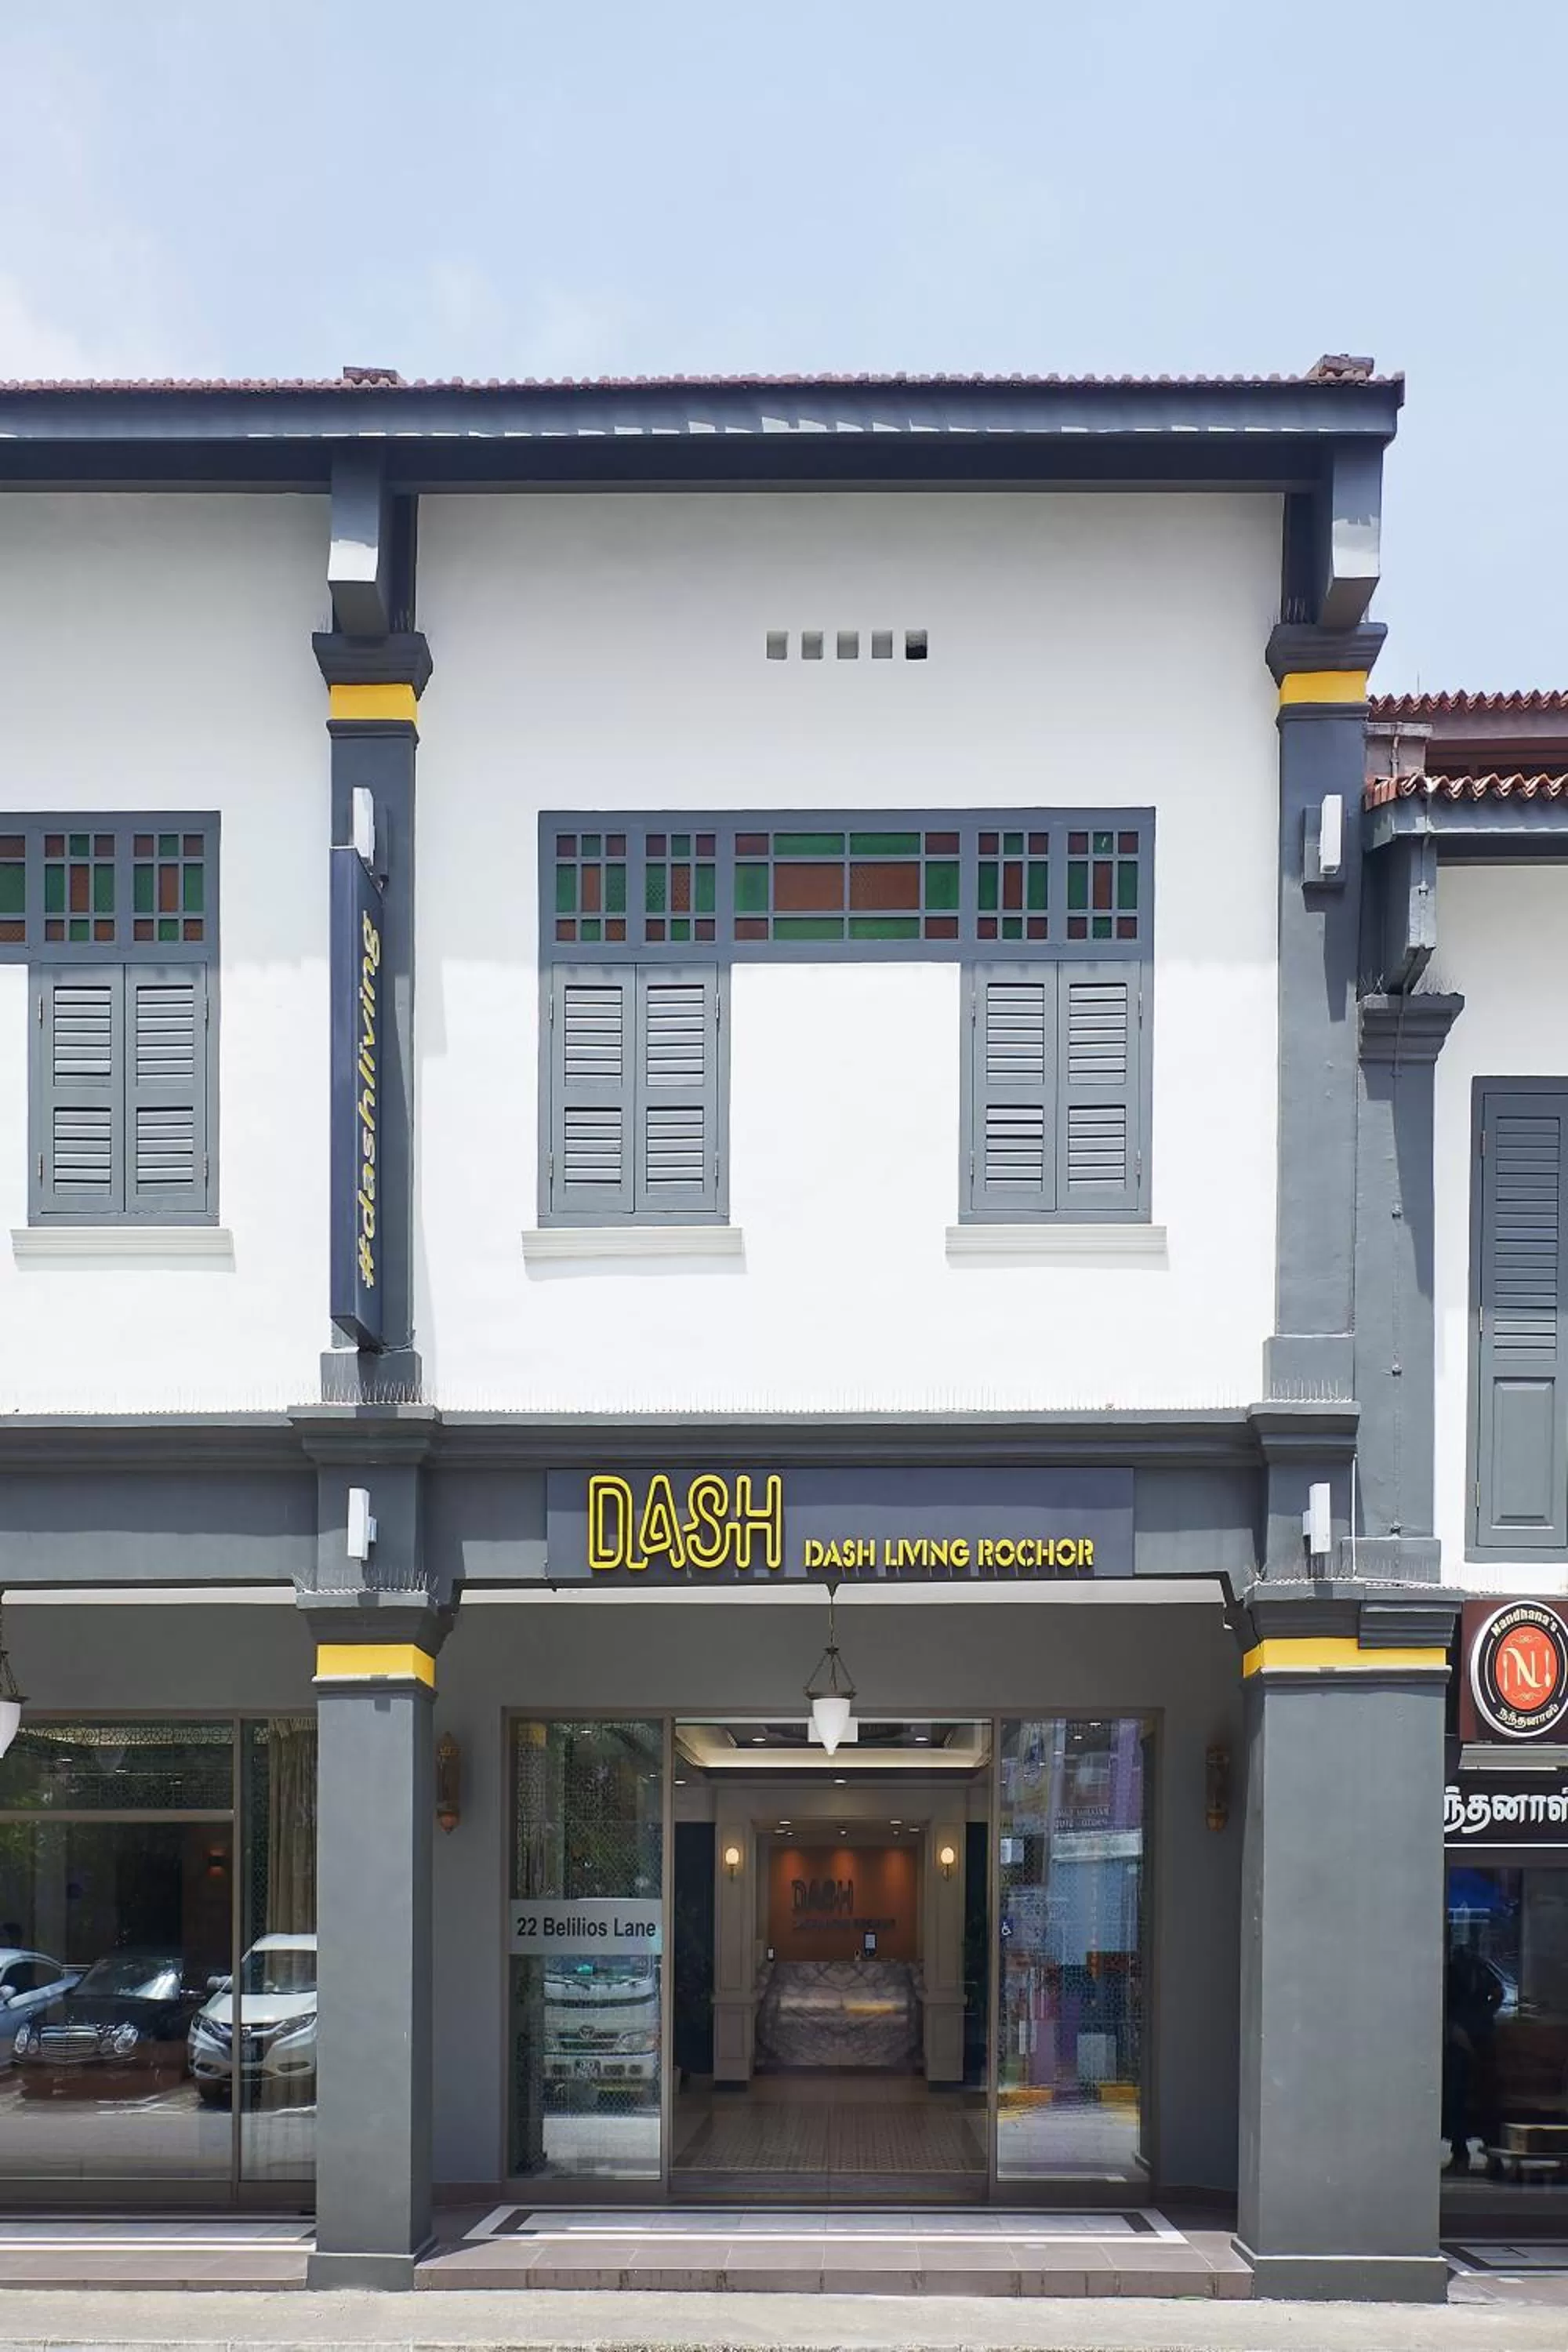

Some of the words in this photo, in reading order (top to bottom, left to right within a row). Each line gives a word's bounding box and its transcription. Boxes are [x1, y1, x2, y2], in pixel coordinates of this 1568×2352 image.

[358, 910, 380, 1288] #dashliving
[588, 1474, 782, 1570] DASH
[804, 1539, 876, 1567] DASH
[884, 1539, 970, 1567] LIVING
[978, 1539, 1094, 1567] ROCHOR
[1490, 1608, 1558, 1637] Nandhana's
[517, 1918, 537, 1936] 22
[543, 1917, 608, 1937] Belilios
[614, 1918, 656, 1937] Lane
